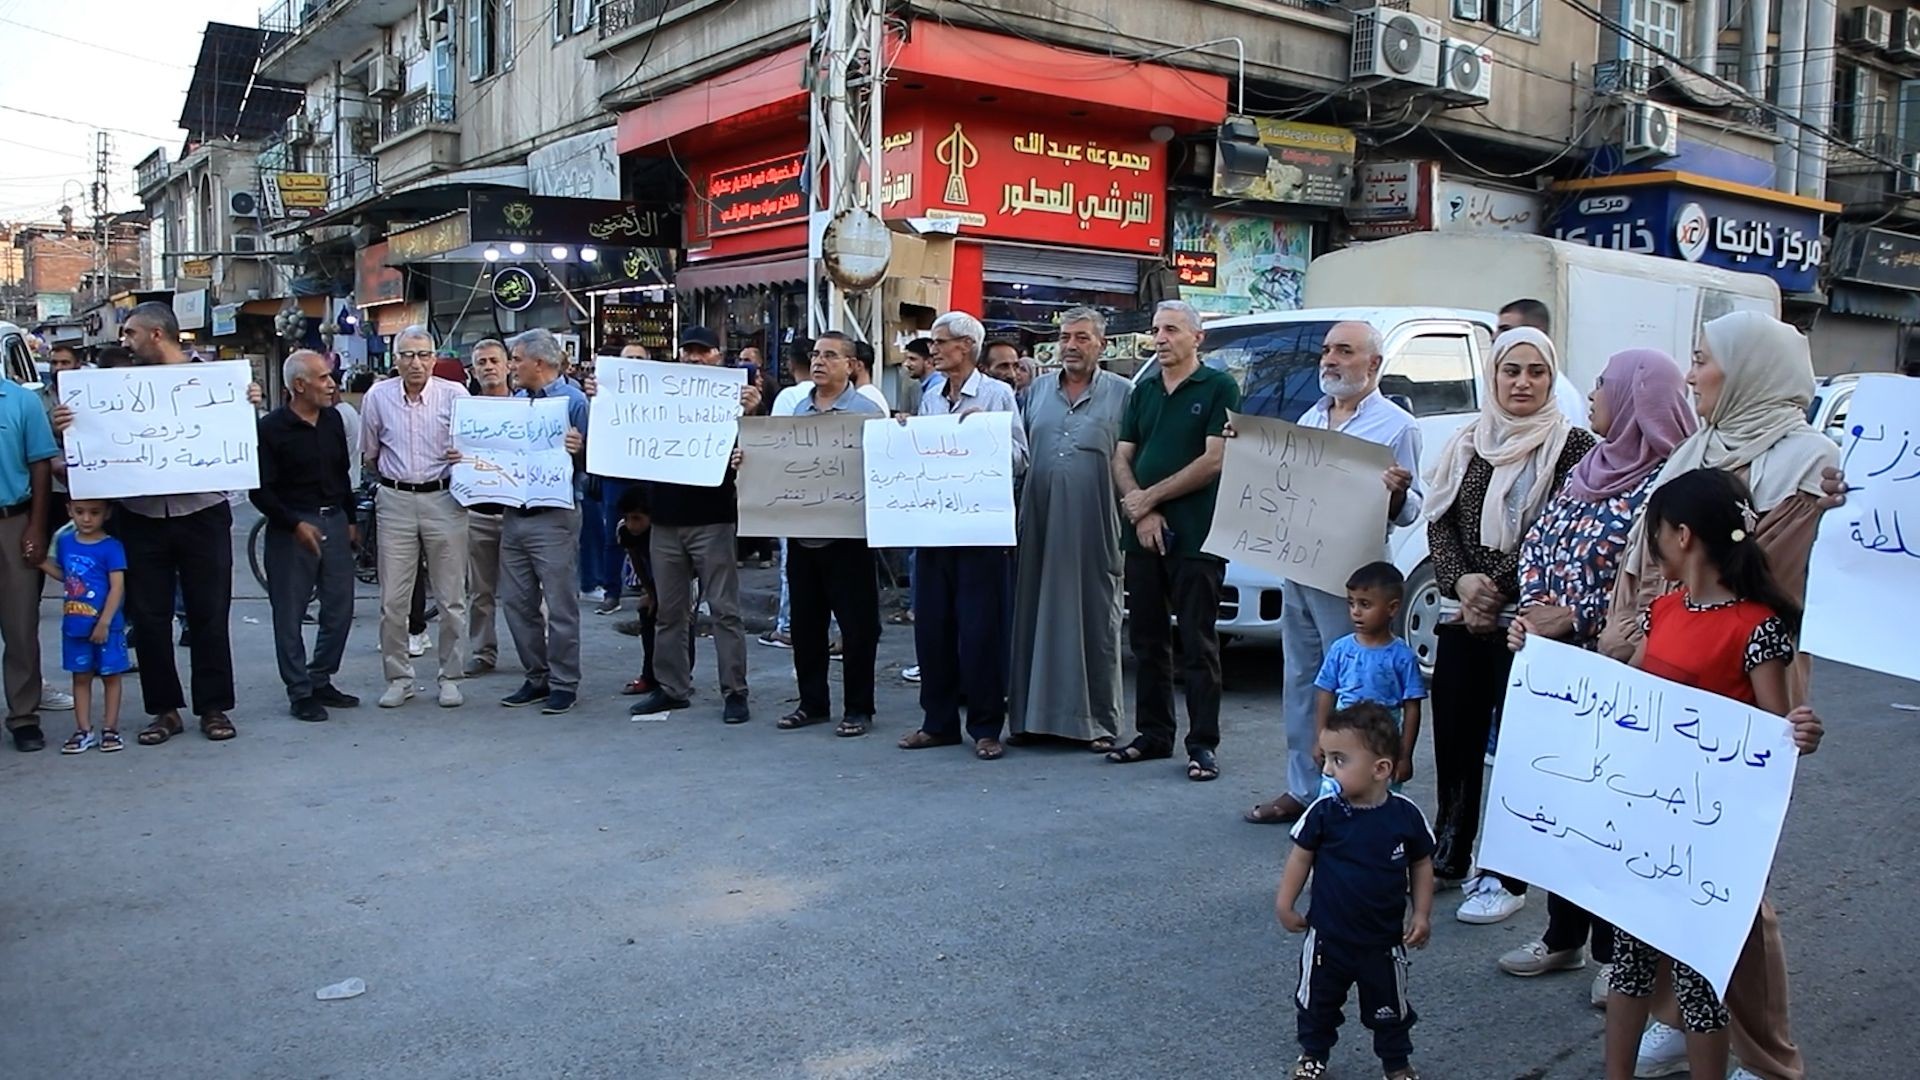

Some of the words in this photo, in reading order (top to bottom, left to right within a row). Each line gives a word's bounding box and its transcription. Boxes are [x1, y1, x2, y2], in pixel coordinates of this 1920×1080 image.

[1013, 131, 1044, 155] الله
[1047, 140, 1083, 166] عبد
[1086, 141, 1151, 176] مجموعة
[999, 177, 1074, 216] للعطور
[1365, 169, 1407, 187] صيدلية
[1078, 180, 1153, 230] القرشي
[1468, 193, 1532, 230] صيدلية
[1584, 198, 1623, 212] مركز
[1716, 216, 1774, 263] خانيكا
[1776, 227, 1821, 272] مركز
[617, 367, 649, 394] Em
[1258, 426, 1325, 468] NAN
[802, 486, 830, 507] لا
[1233, 529, 1324, 568] AZADÎ
[1672, 707, 1771, 768] محاربة
[1531, 753, 1611, 783] كل
[1605, 771, 1722, 826] واجب
[1501, 795, 1623, 852] شريف
